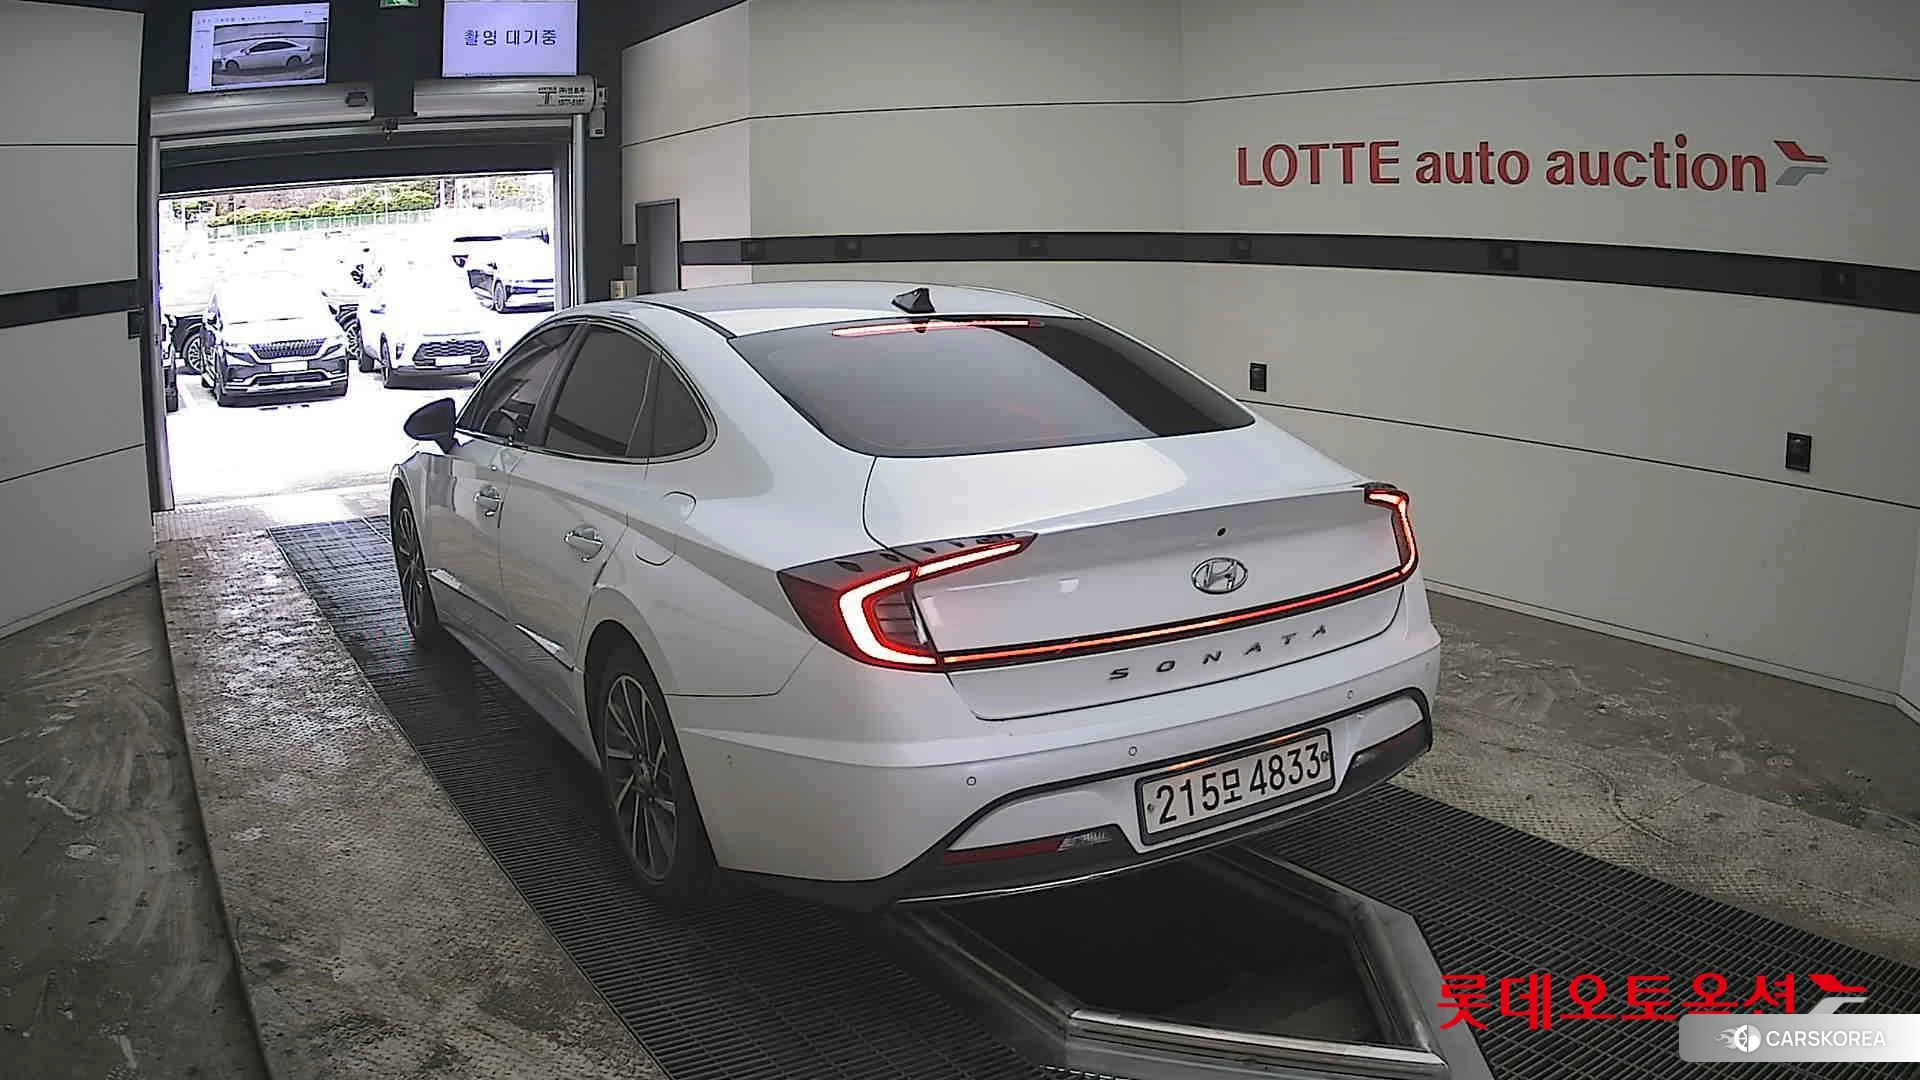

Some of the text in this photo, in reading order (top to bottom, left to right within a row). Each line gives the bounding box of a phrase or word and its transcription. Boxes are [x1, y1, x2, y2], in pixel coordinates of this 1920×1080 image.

[505, 29, 557, 46] 대기중
[1237, 133, 1768, 193] LOTTE auto auction
[1109, 624, 1328, 681] SONATA
[1249, 743, 1321, 796] 4833
